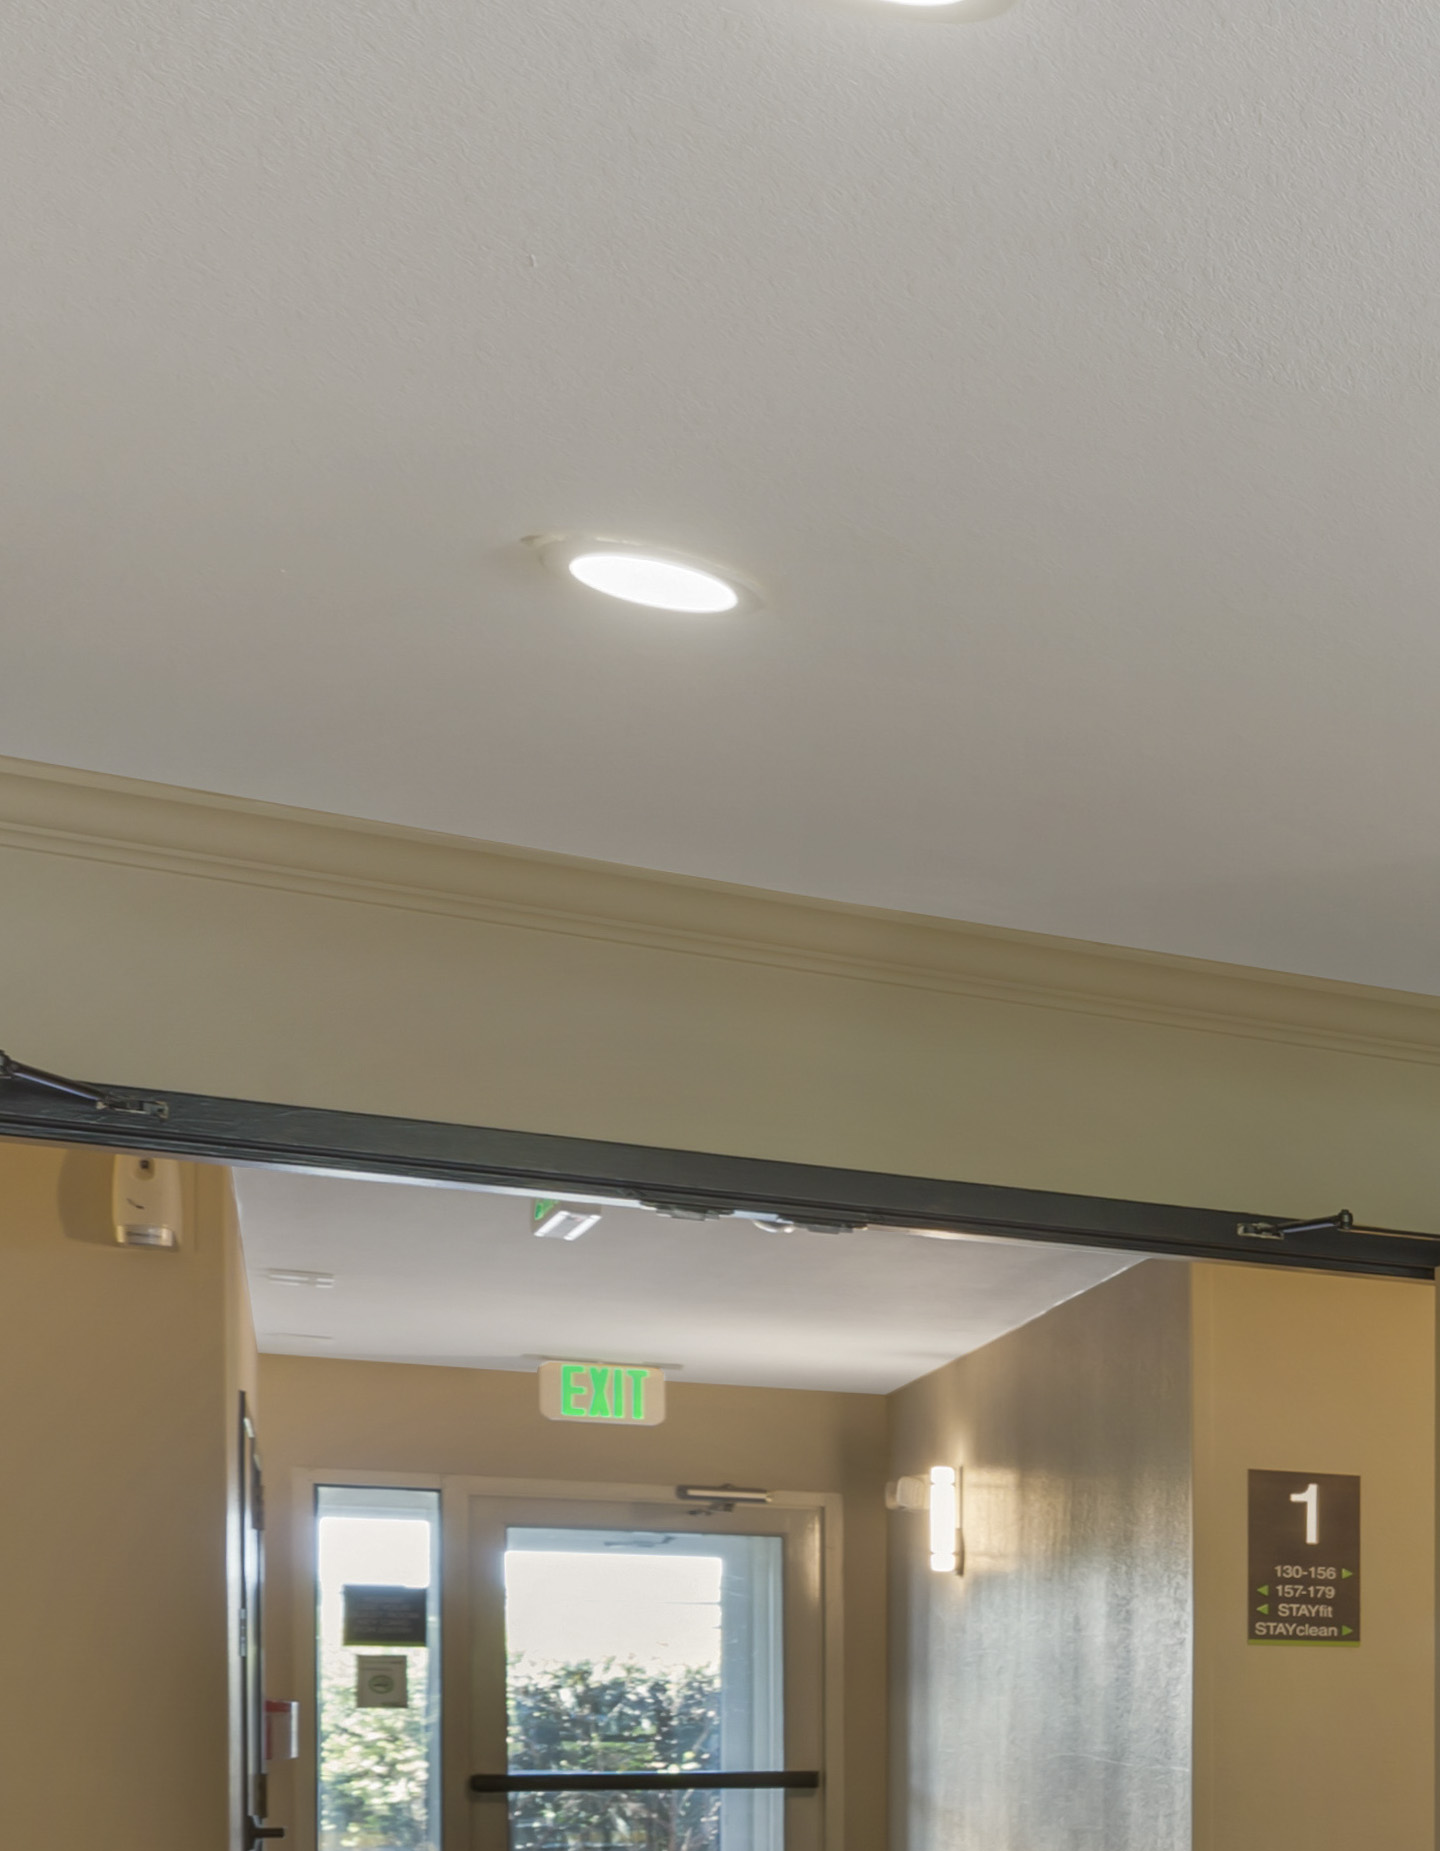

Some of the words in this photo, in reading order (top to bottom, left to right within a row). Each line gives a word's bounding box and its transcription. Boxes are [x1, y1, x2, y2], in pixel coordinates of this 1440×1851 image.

[560, 1364, 650, 1420] EXIT
[1290, 1483, 1319, 1545] 1
[1274, 1565, 1337, 1580] 130-156
[1275, 1584, 1335, 1599] 157-179
[1277, 1603, 1334, 1618] STAYfit
[1254, 1622, 1338, 1637] STAYclean
